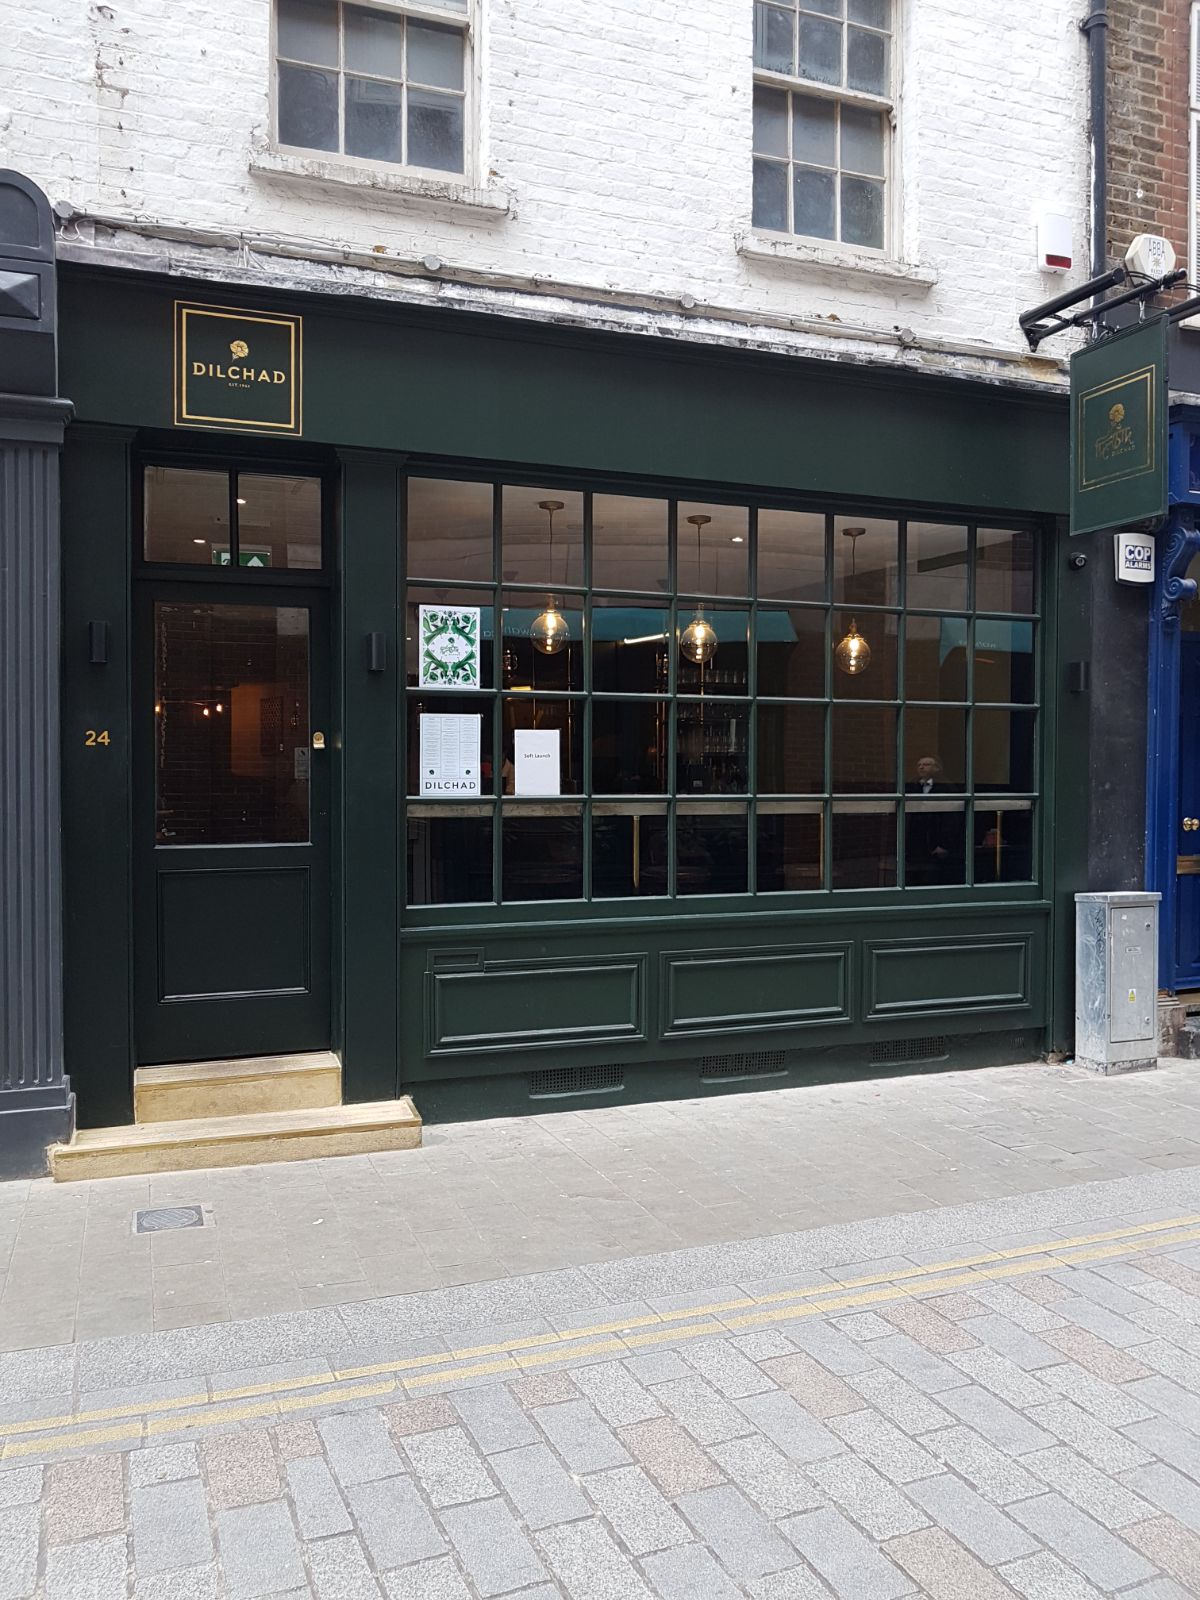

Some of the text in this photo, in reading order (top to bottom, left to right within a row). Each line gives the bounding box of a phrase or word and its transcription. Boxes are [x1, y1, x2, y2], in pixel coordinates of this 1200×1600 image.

[192, 361, 286, 384] DILCHAD
[1125, 545, 1151, 561] COP
[1125, 560, 1152, 570] ALARMS
[85, 730, 111, 746] 24
[425, 781, 476, 790] DILCHAD
